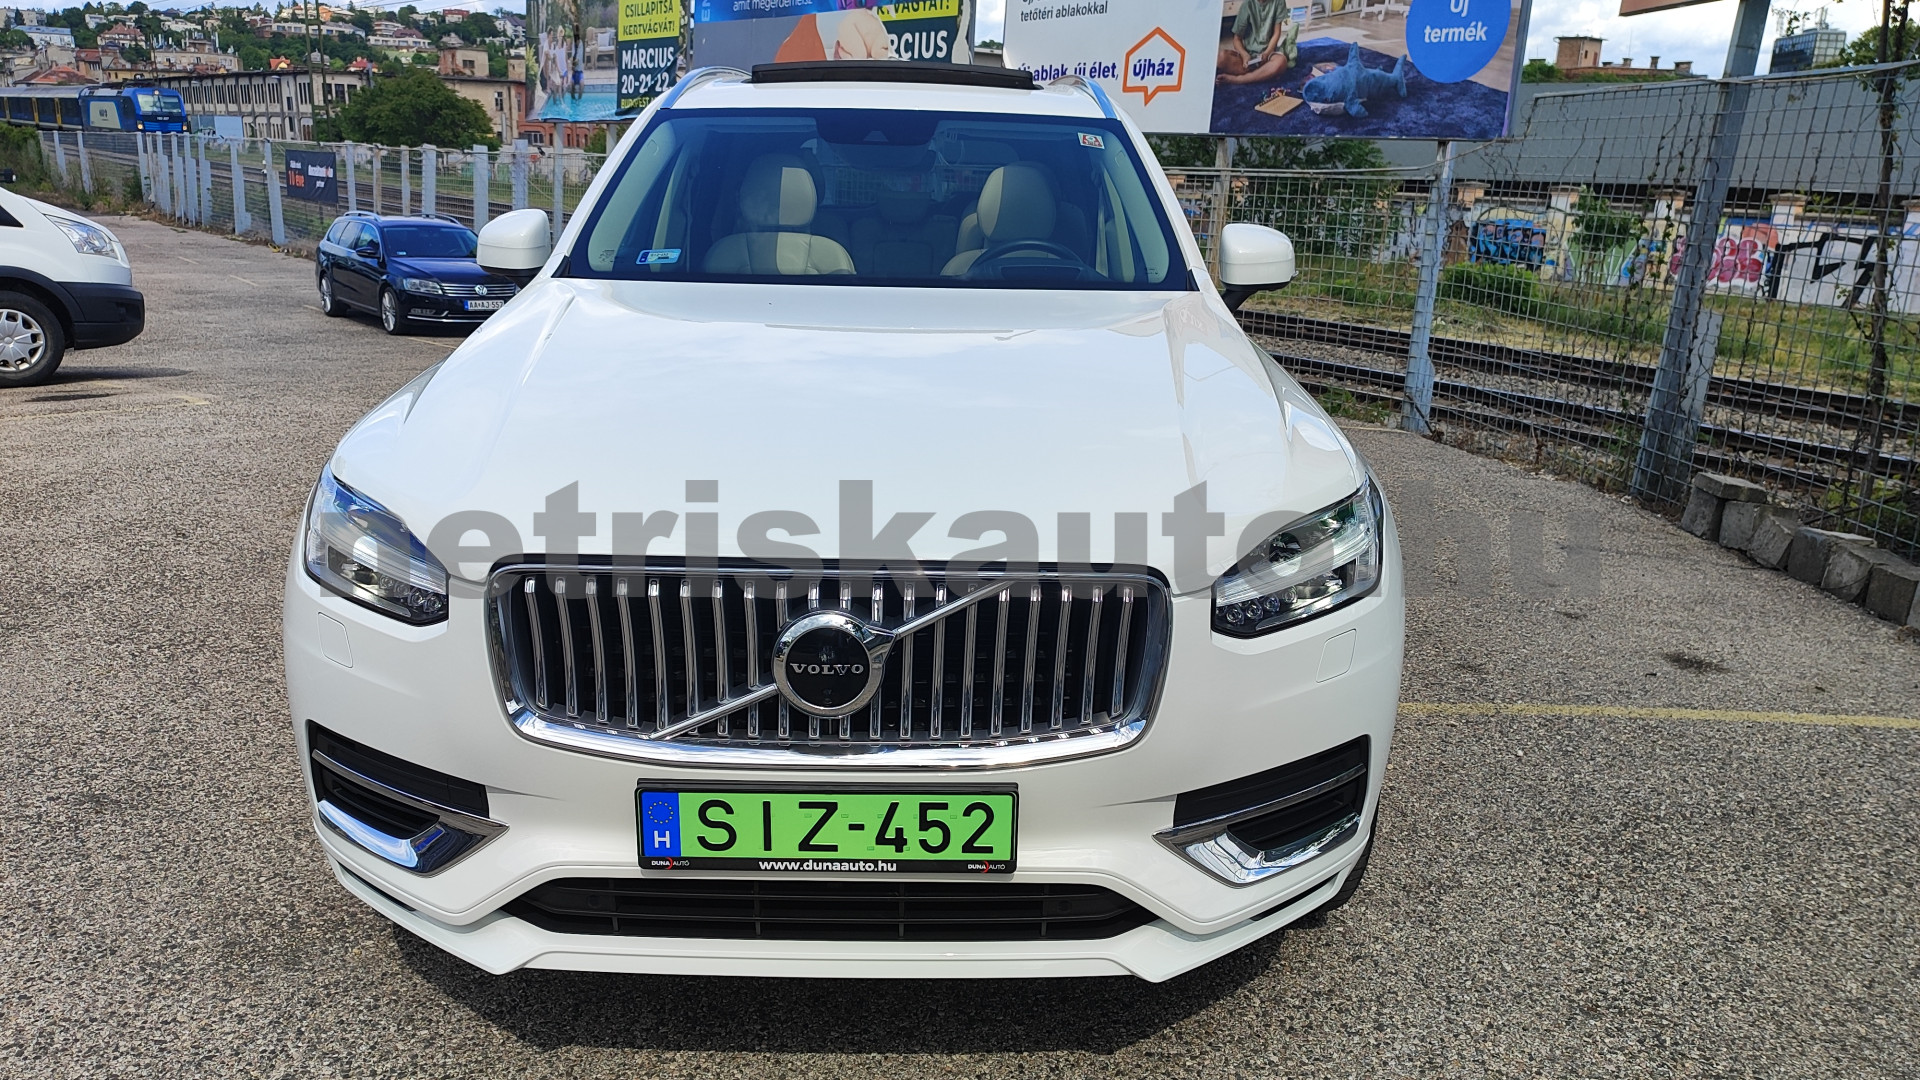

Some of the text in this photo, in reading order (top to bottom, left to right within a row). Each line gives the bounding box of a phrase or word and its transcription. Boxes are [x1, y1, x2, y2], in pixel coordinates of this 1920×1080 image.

[1020, 0, 1108, 22] tetőtéri ablakokkal
[623, 17, 675, 36] KERTVÁGYÁT!
[1424, 21, 1488, 43] termék
[886, 30, 948, 60] RCIUS
[622, 43, 674, 70] MÁRCIUS
[1089, 61, 1119, 81] élet,
[1133, 57, 1175, 81] újház
[790, 662, 864, 676] VOLVO
[653, 799, 995, 854] H SIZ-452
[758, 859, 898, 873] www.dunaauto.hu
